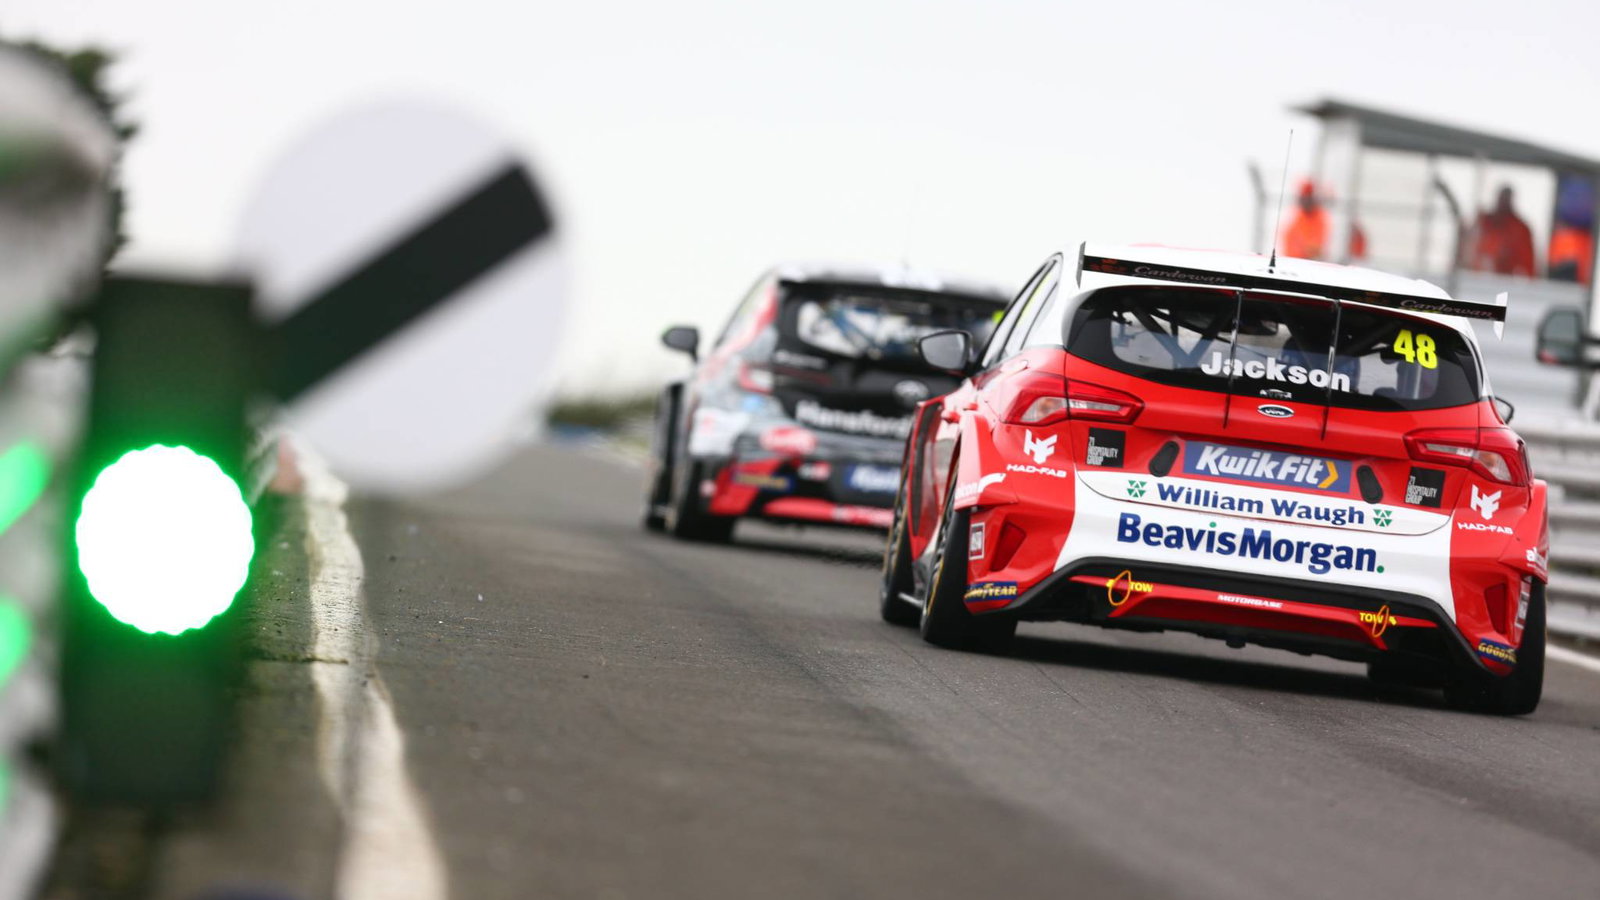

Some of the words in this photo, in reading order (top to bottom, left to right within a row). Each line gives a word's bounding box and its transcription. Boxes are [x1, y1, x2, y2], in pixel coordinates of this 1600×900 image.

[1394, 329, 1438, 369] 48
[1201, 352, 1350, 392] Jackson
[1006, 464, 1067, 478] HAD-FAB
[1157, 483, 1263, 514] William
[1271, 498, 1365, 526] Waugh
[1457, 522, 1514, 535] HAD-FAB
[1130, 581, 1153, 593] TOW
[1360, 612, 1384, 624] TOW
